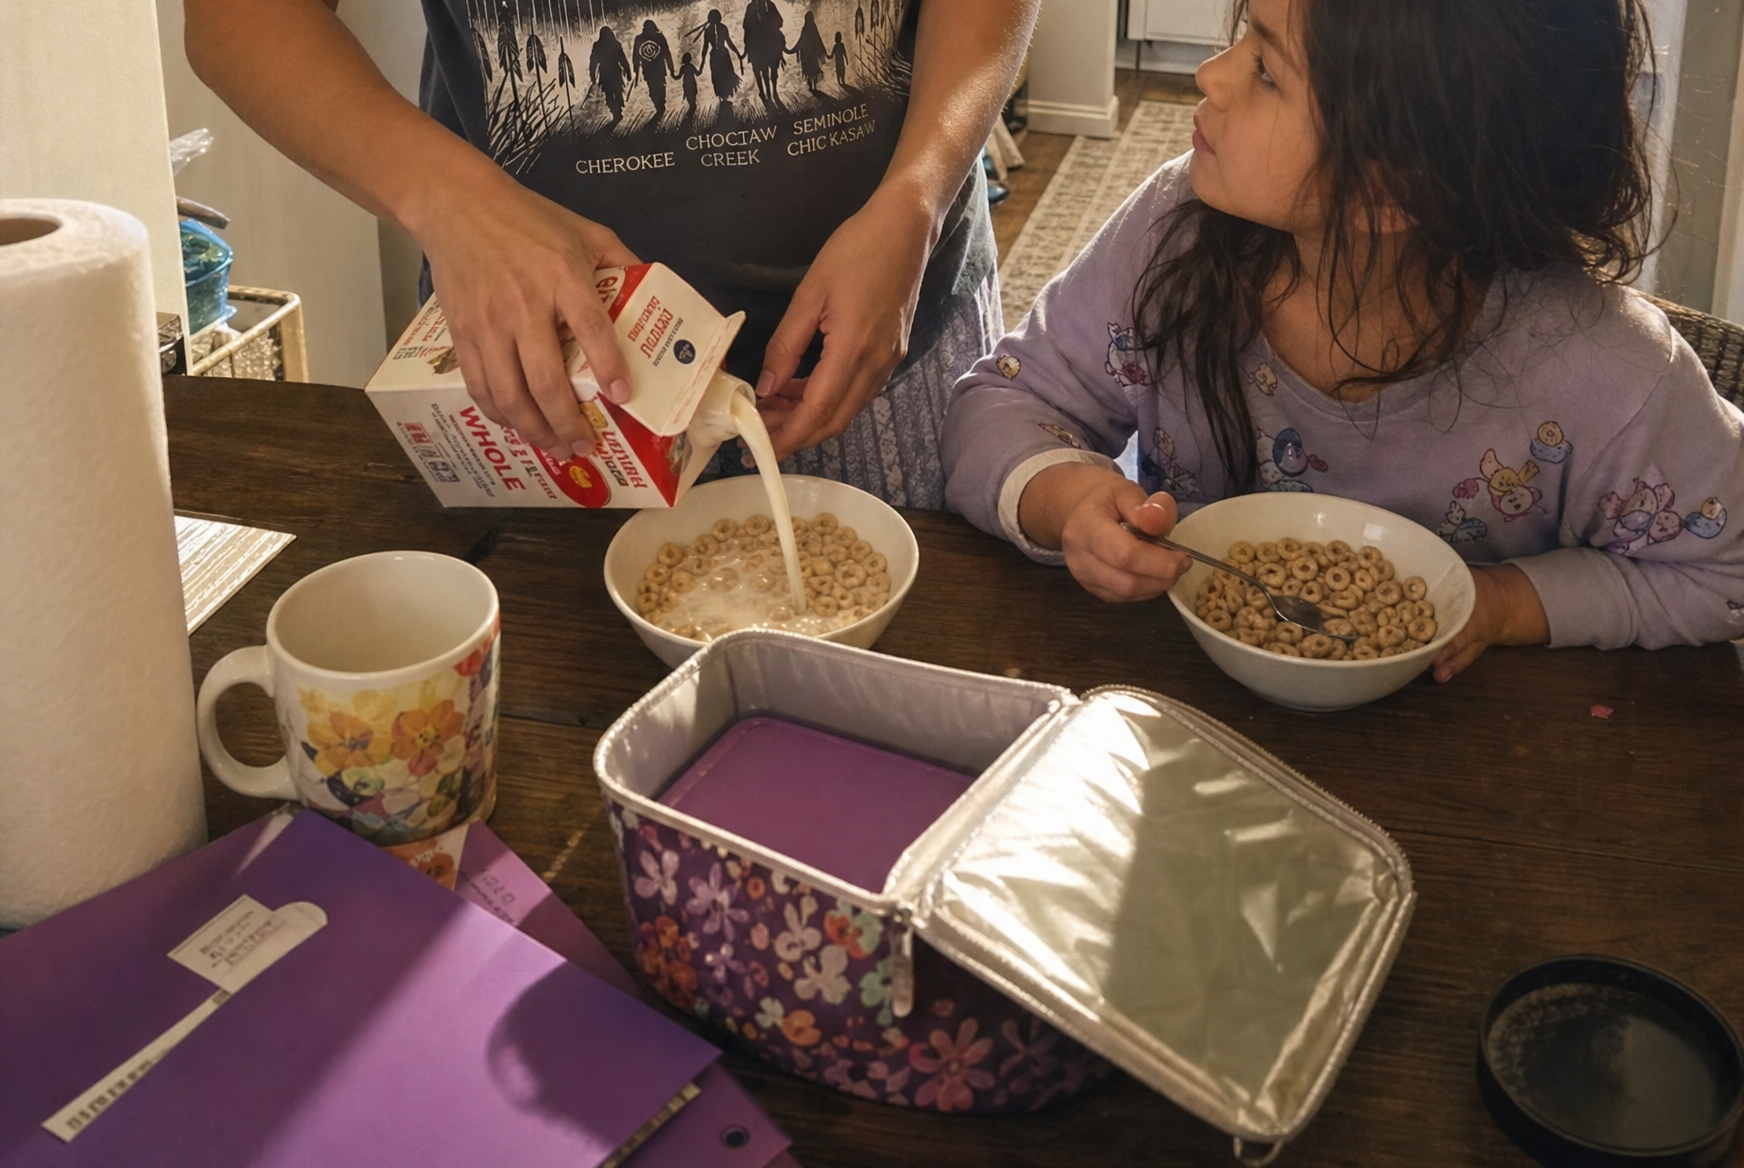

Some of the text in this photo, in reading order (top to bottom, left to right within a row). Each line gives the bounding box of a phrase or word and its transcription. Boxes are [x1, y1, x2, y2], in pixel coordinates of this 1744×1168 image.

[685, 103, 869, 151] CHOCTAW SEMINOLE
[575, 152, 676, 174] CHEROKEE
[700, 149, 760, 167] CREEK
[460, 405, 526, 490] WHOLE
